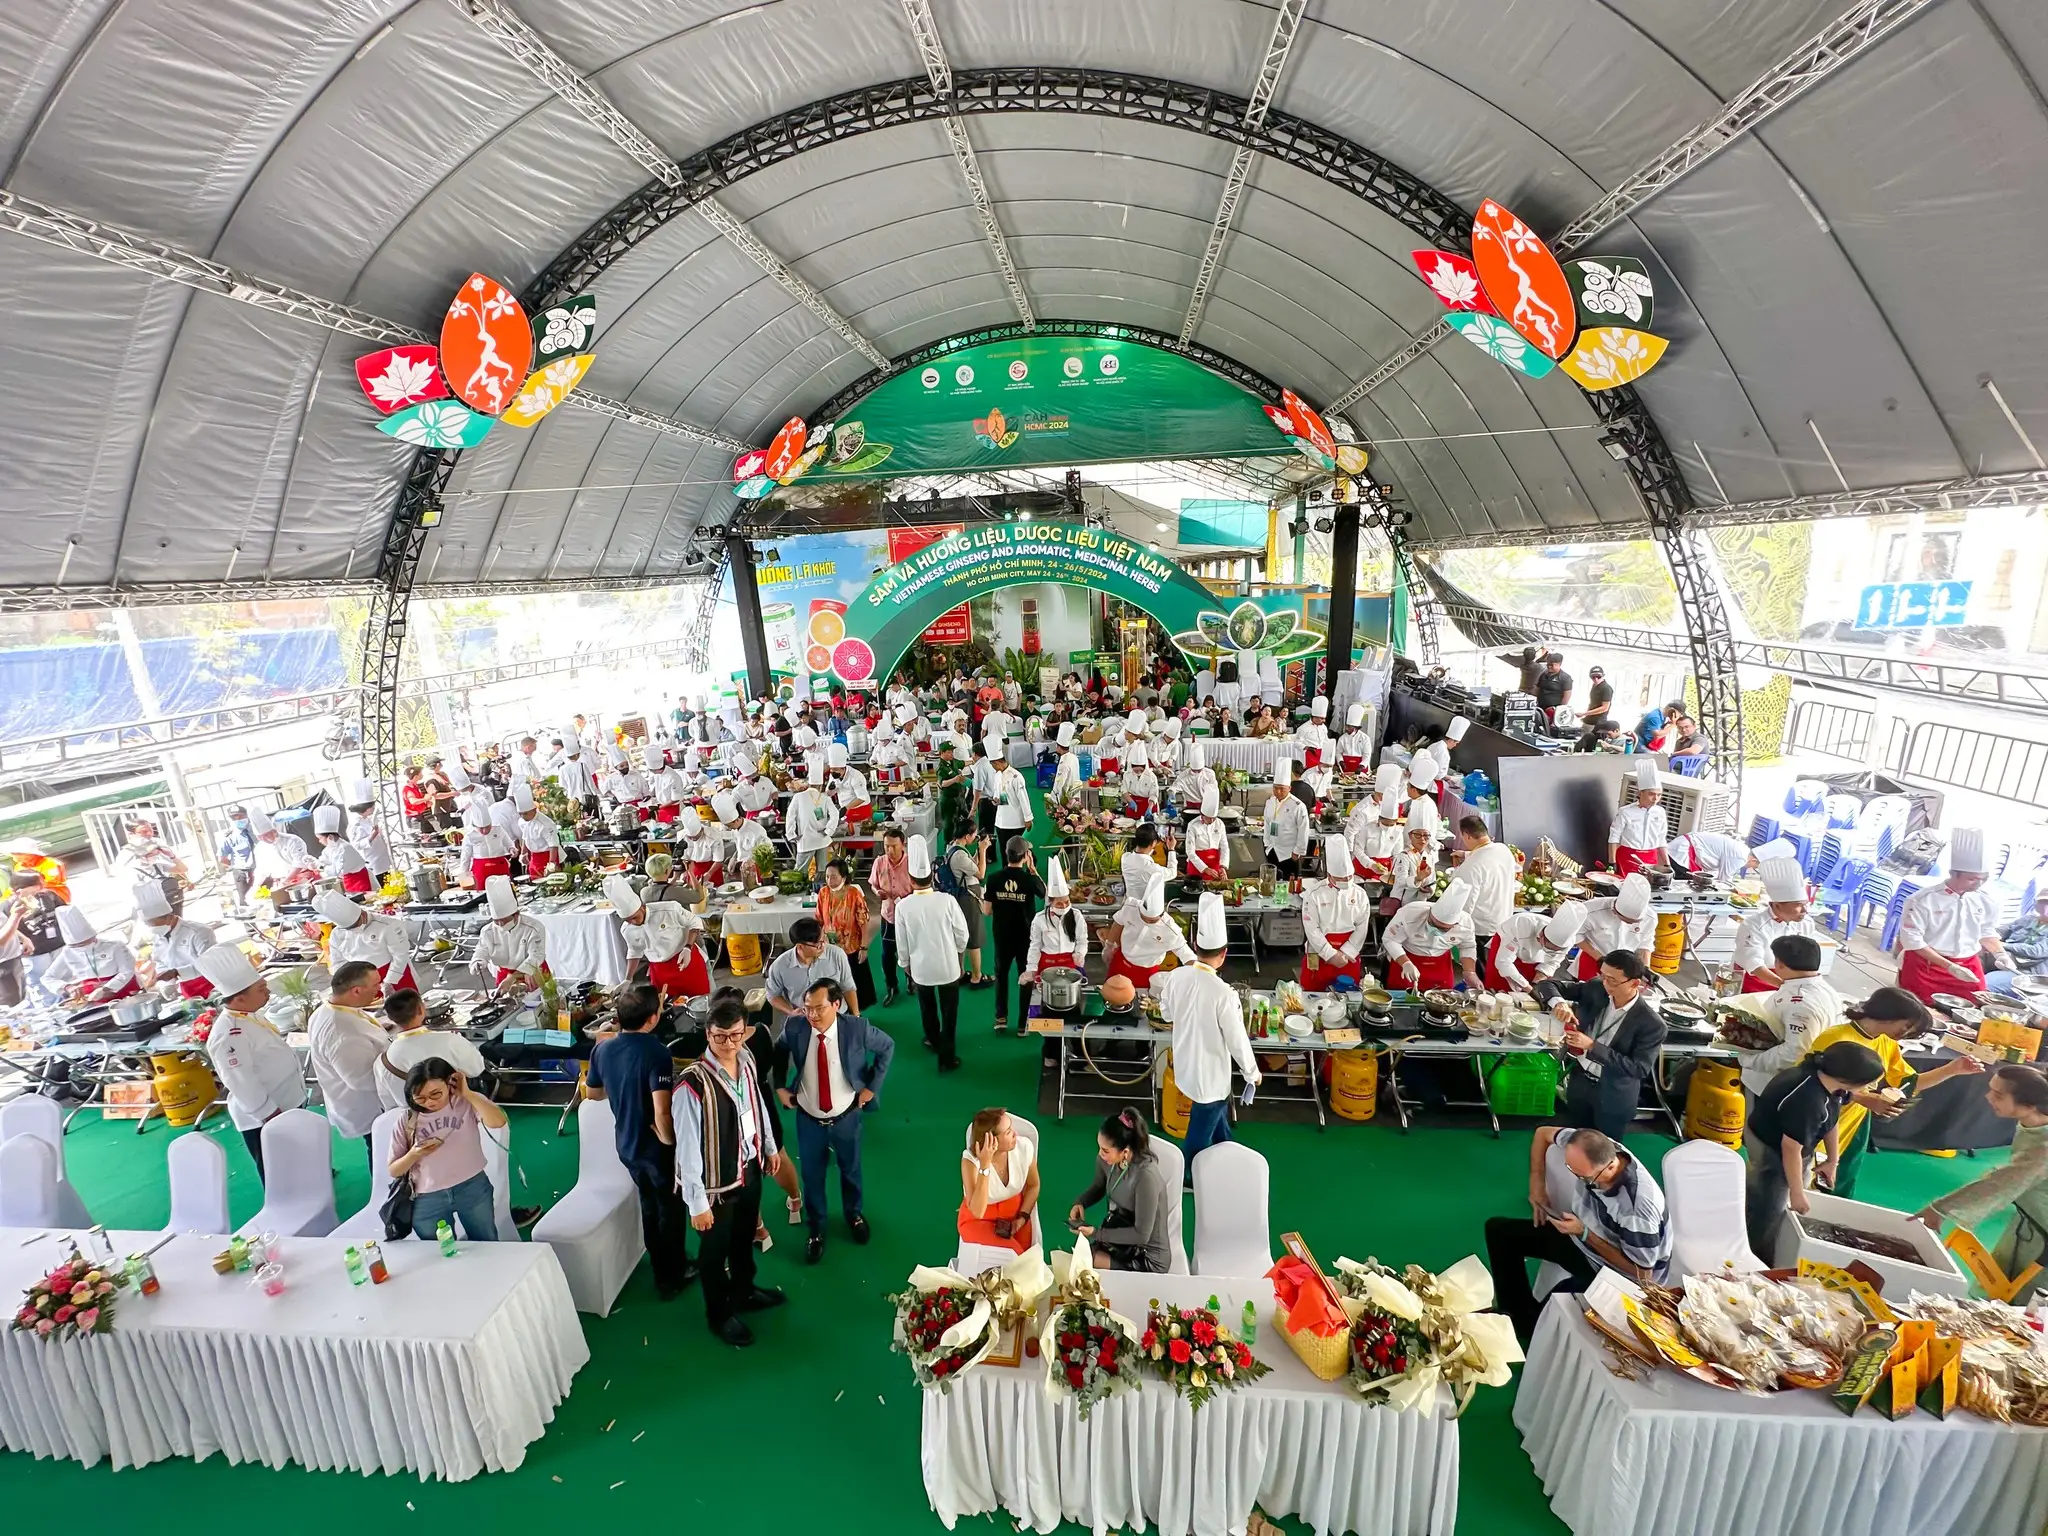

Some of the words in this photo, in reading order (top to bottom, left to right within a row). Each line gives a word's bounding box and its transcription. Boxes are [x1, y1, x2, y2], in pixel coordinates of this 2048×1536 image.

[1024, 422, 1048, 431] HCMC
[1048, 421, 1069, 429] 2024
[868, 577, 899, 607] SÂM
[896, 562, 917, 583] VÀ
[916, 537, 972, 571] HƯƠNG
[974, 527, 1011, 549] LIỆU,
[1014, 525, 1063, 544] DƯỢC
[1066, 529, 1100, 549] LIỆU
[1103, 537, 1136, 562] VIỆT
[1135, 552, 1173, 583] NAM
[891, 565, 947, 605] VIETNAMESE
[946, 550, 990, 572] GINSENG
[991, 547, 1014, 558] AND
[1015, 544, 1073, 560] AROMATIC,
[1074, 550, 1128, 577] MEDICINAL
[1129, 569, 1161, 594] HERBS
[943, 571, 970, 587] THÀNH
[970, 562, 989, 577] PHỐ
[1004, 558, 1020, 570] CHÍ
[1021, 559, 1046, 569] MINH,
[1047, 560, 1058, 568] 24
[1064, 562, 1108, 581] 26/5/2024
[966, 579, 977, 588] HO
[977, 576, 990, 584] CHI
[991, 572, 1009, 580] MINH
[1009, 570, 1026, 578] CITY,
[1072, 575, 1088, 584] 2024
[1789, 1024, 1803, 1033] TTC
[418, 1116, 465, 1139] RIENDS
